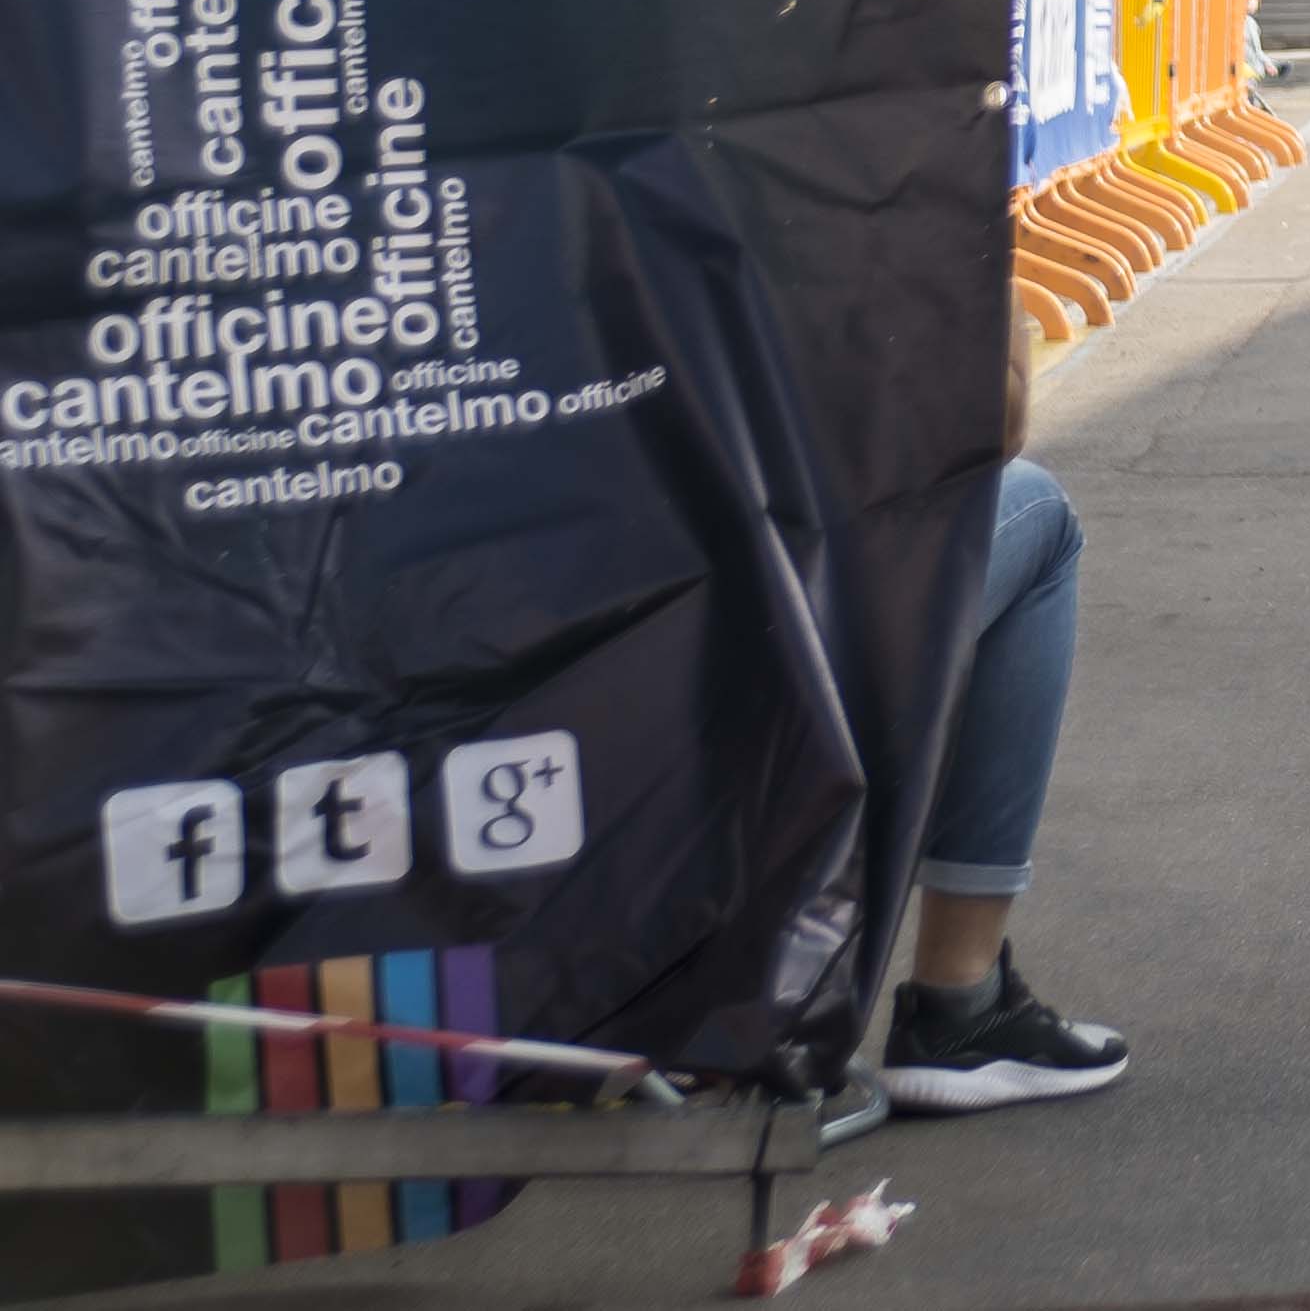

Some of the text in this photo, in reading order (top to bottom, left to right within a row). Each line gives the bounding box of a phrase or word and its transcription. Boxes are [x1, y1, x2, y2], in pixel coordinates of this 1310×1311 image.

[122, 38, 155, 188] cantelmo
[136, 187, 351, 241] officine
[367, 76, 440, 347] officine
[88, 234, 360, 289] cantelmo
[437, 176, 480, 350] cantelmo
[89, 289, 390, 365] officine
[0, 363, 668, 472] antelmo officine cantelmo officine
[1, 352, 521, 431] cantelmo officine
[184, 458, 403, 513] cantelmo
